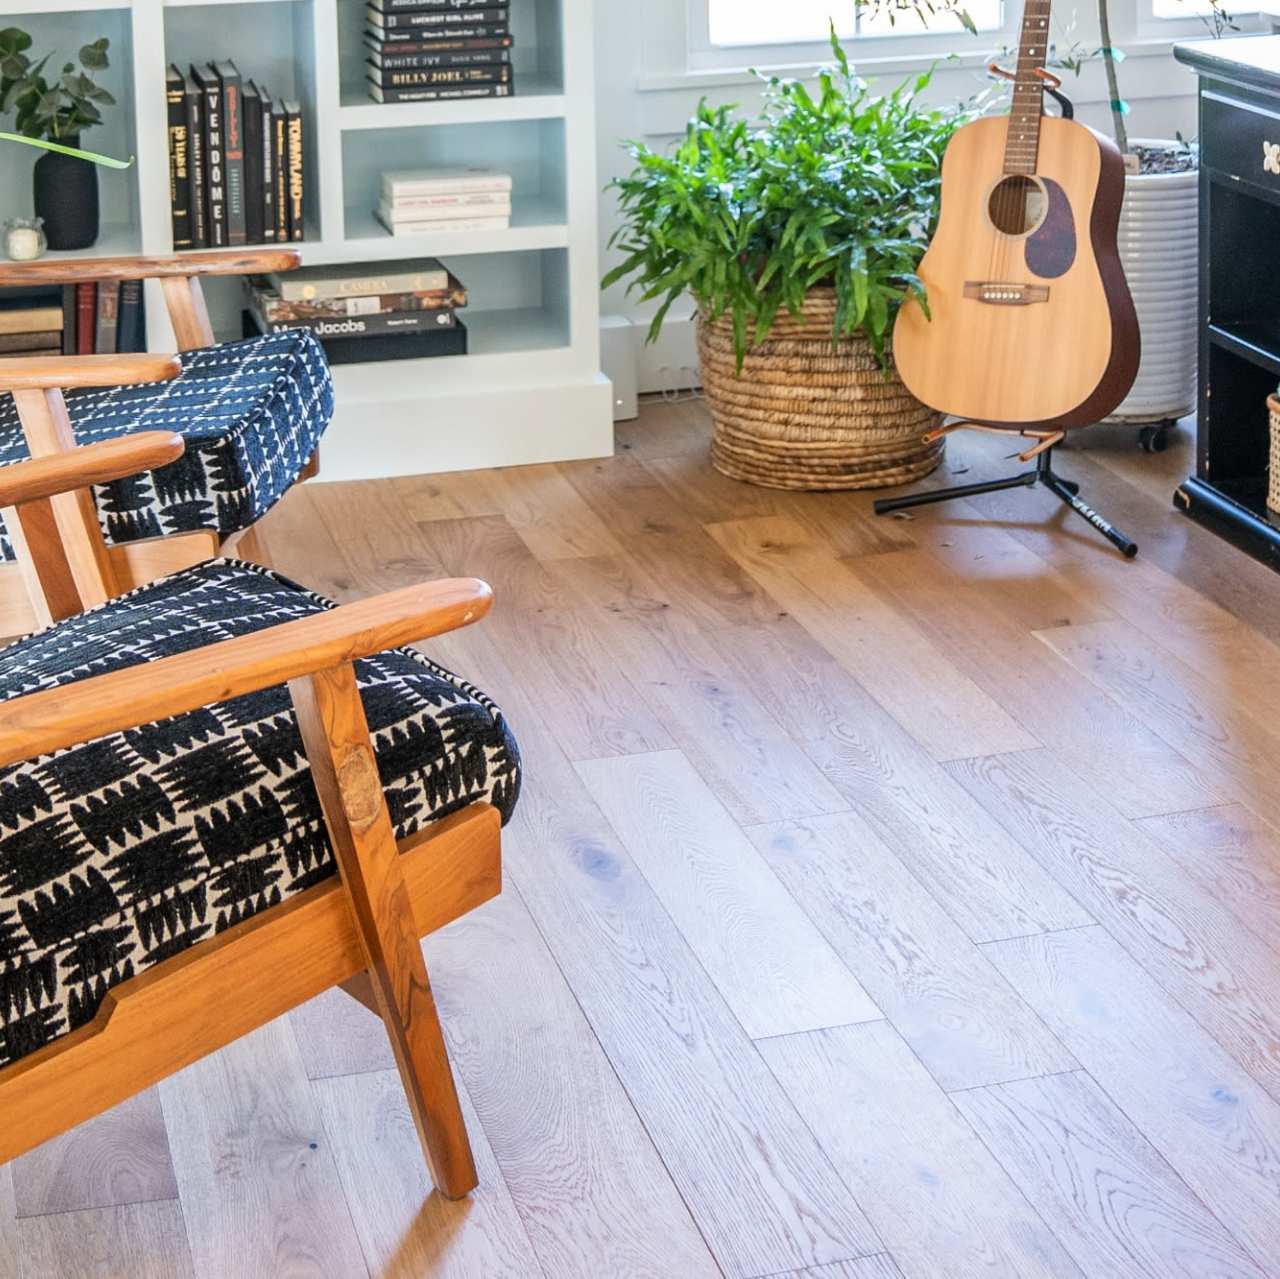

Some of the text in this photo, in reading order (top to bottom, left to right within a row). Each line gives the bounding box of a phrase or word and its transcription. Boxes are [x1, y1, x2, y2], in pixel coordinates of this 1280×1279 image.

[411, 13, 484, 24] LUCKIEST GIRL ALIVE
[384, 58, 418, 68] WHITE
[422, 56, 440, 66] IVY
[392, 73, 429, 84] BILLY
[431, 71, 463, 83] JOEL
[288, 118, 303, 199] TOMMYLAND
[314, 319, 366, 334] Jacobs
